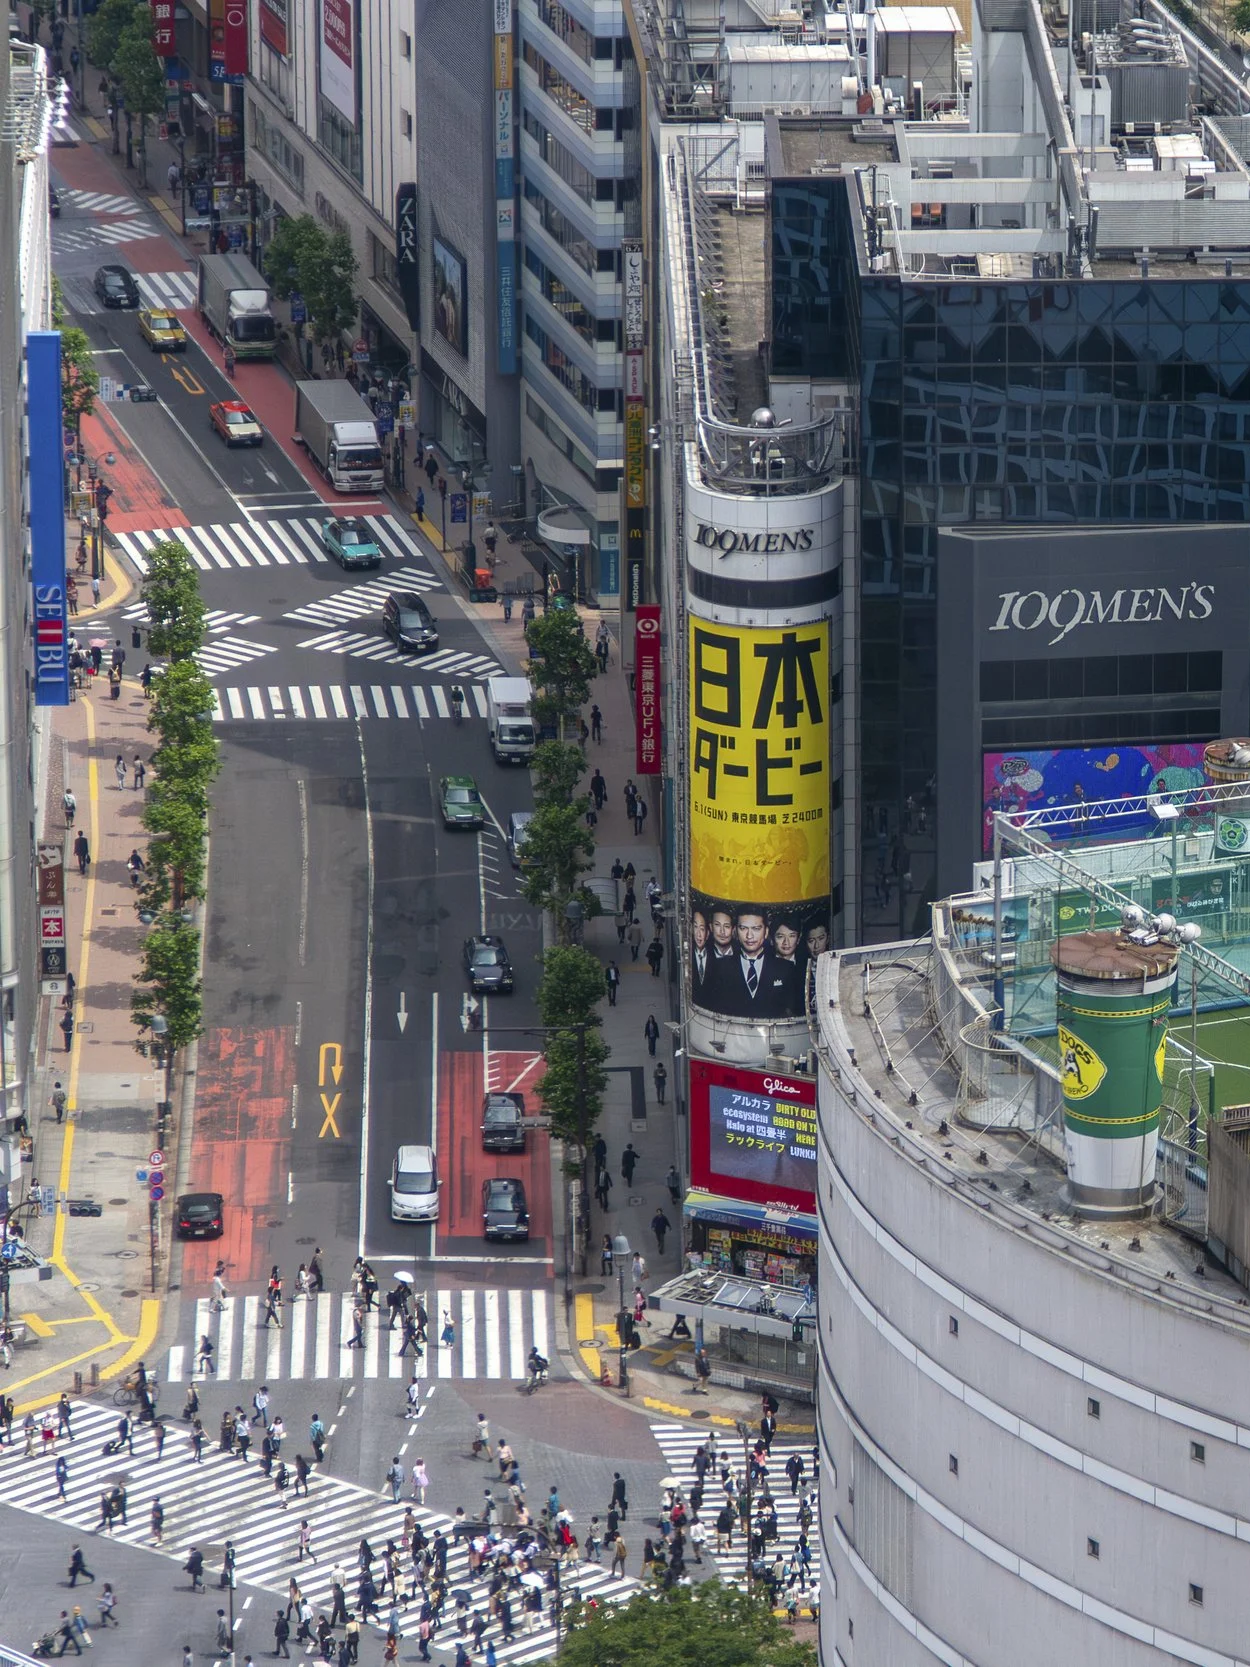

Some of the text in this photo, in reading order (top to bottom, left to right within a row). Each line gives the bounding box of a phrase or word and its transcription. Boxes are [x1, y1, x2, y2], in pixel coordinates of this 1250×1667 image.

[400, 198, 416, 263] ZARA
[35, 584, 65, 682] SEIBU
[988, 581, 1215, 646] 109MEN'S
[694, 626, 824, 730] 日本
[641, 655, 656, 763] 三菱東京UFJ銀行
[693, 726, 823, 807] ダービー
[44, 919, 61, 936] 本
[1060, 1029, 1094, 1065] DOGS
[722, 1107, 769, 1124] ecosystem
[731, 1094, 772, 1111] アルカラ
[775, 1103, 800, 1117] DIRTY
[725, 1132, 785, 1153] ラックライフ
